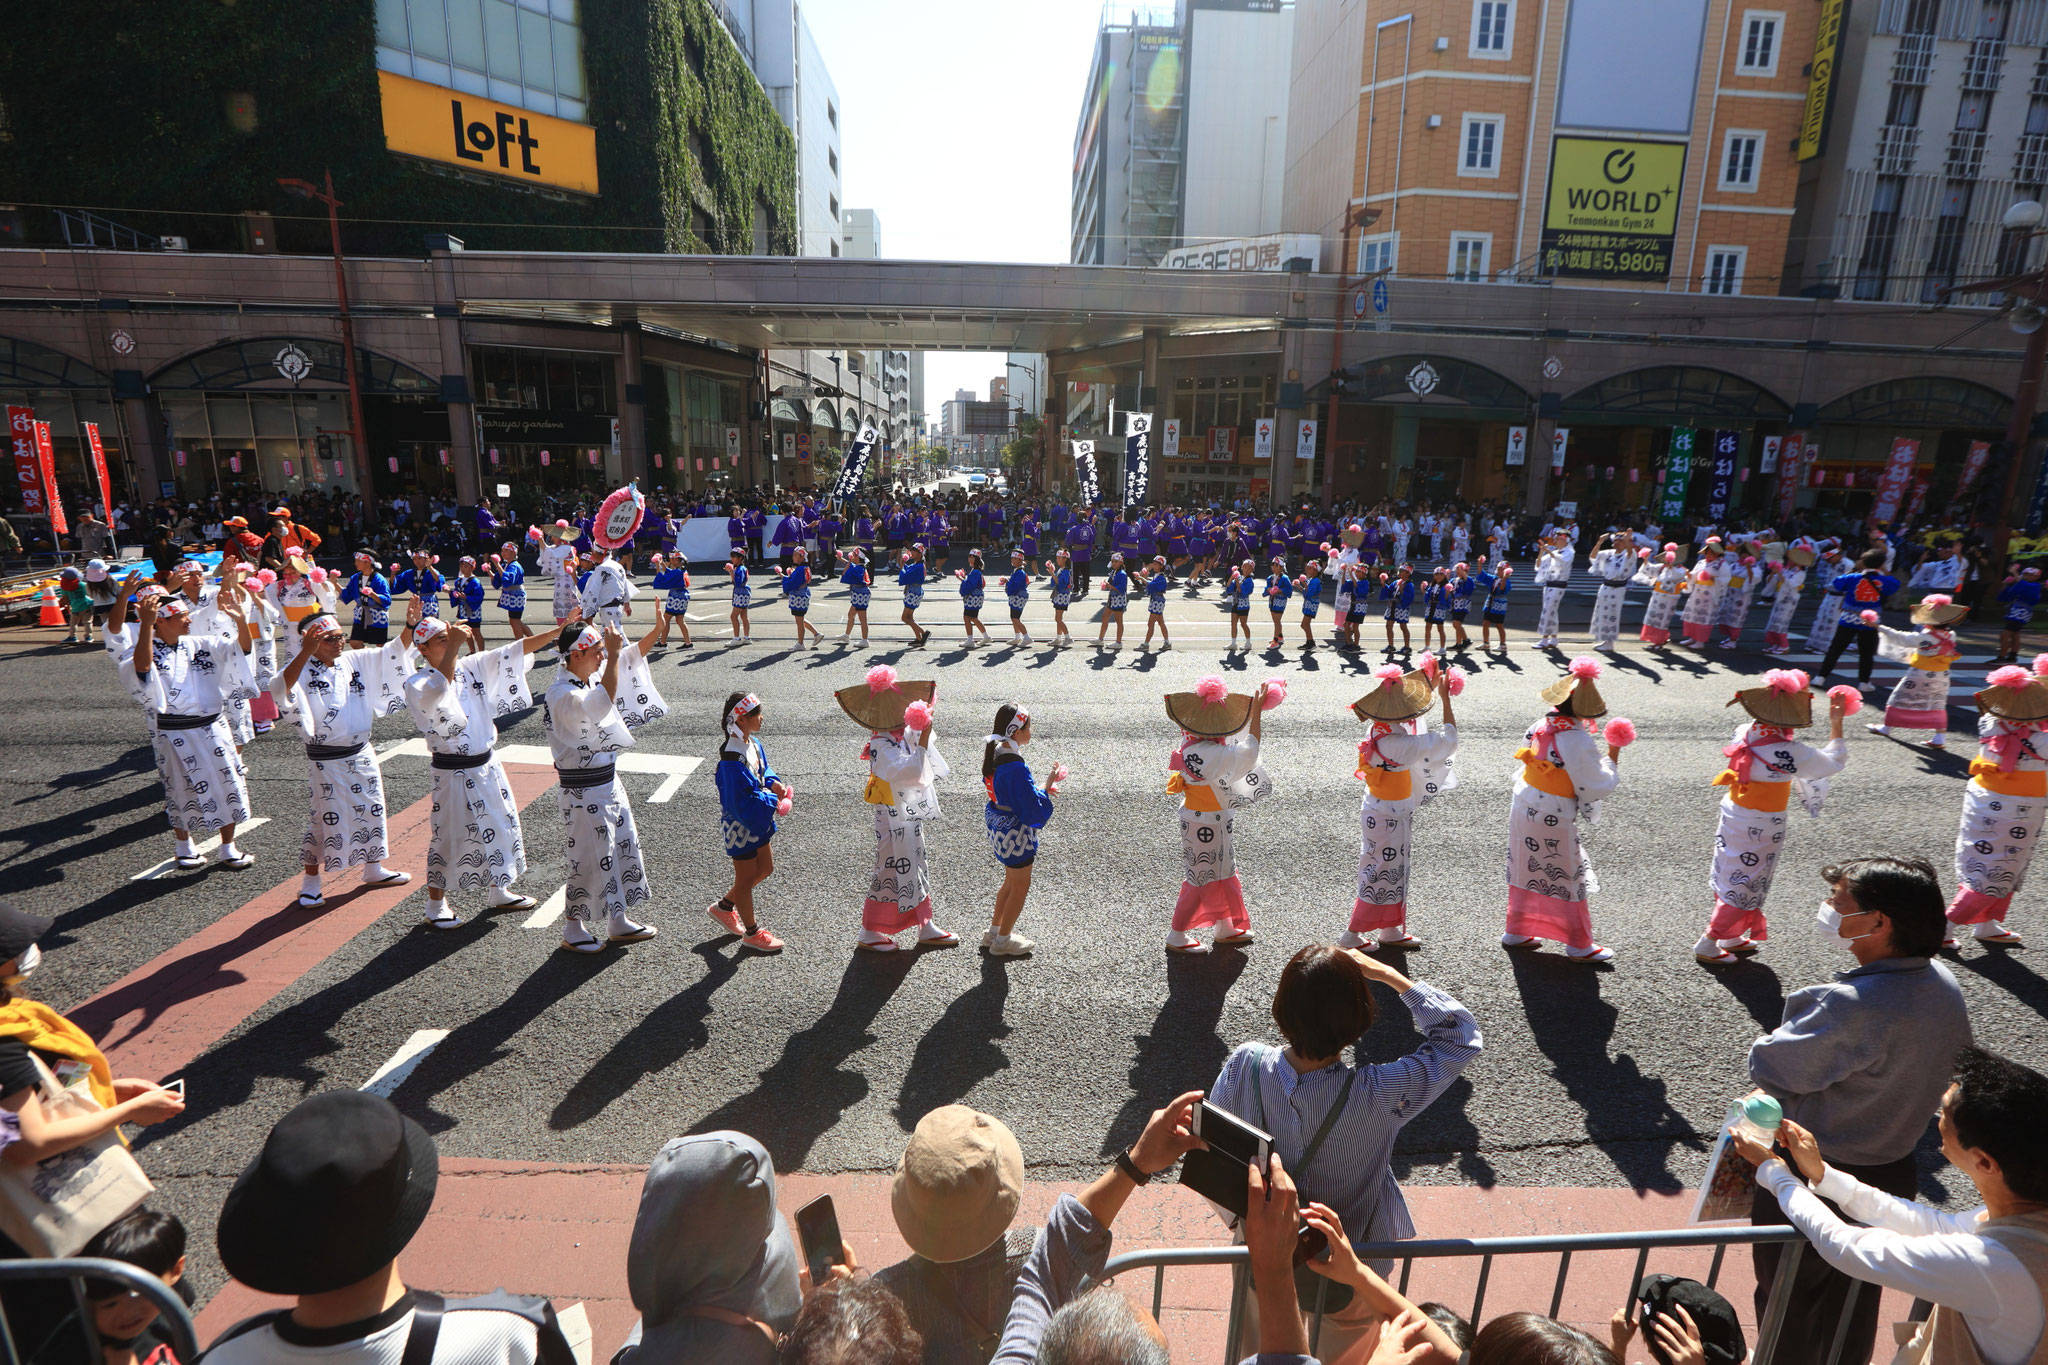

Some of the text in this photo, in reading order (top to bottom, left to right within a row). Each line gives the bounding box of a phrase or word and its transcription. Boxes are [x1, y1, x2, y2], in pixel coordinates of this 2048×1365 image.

[1568, 214, 1654, 230] Tenmonkan Gym 24
[1557, 234, 1659, 251] 24時間営業スポーツジム
[522, 419, 564, 433] gardens
[846, 444, 871, 494] 鹿児島女子
[1135, 434, 1148, 499] 鹿児島女子
